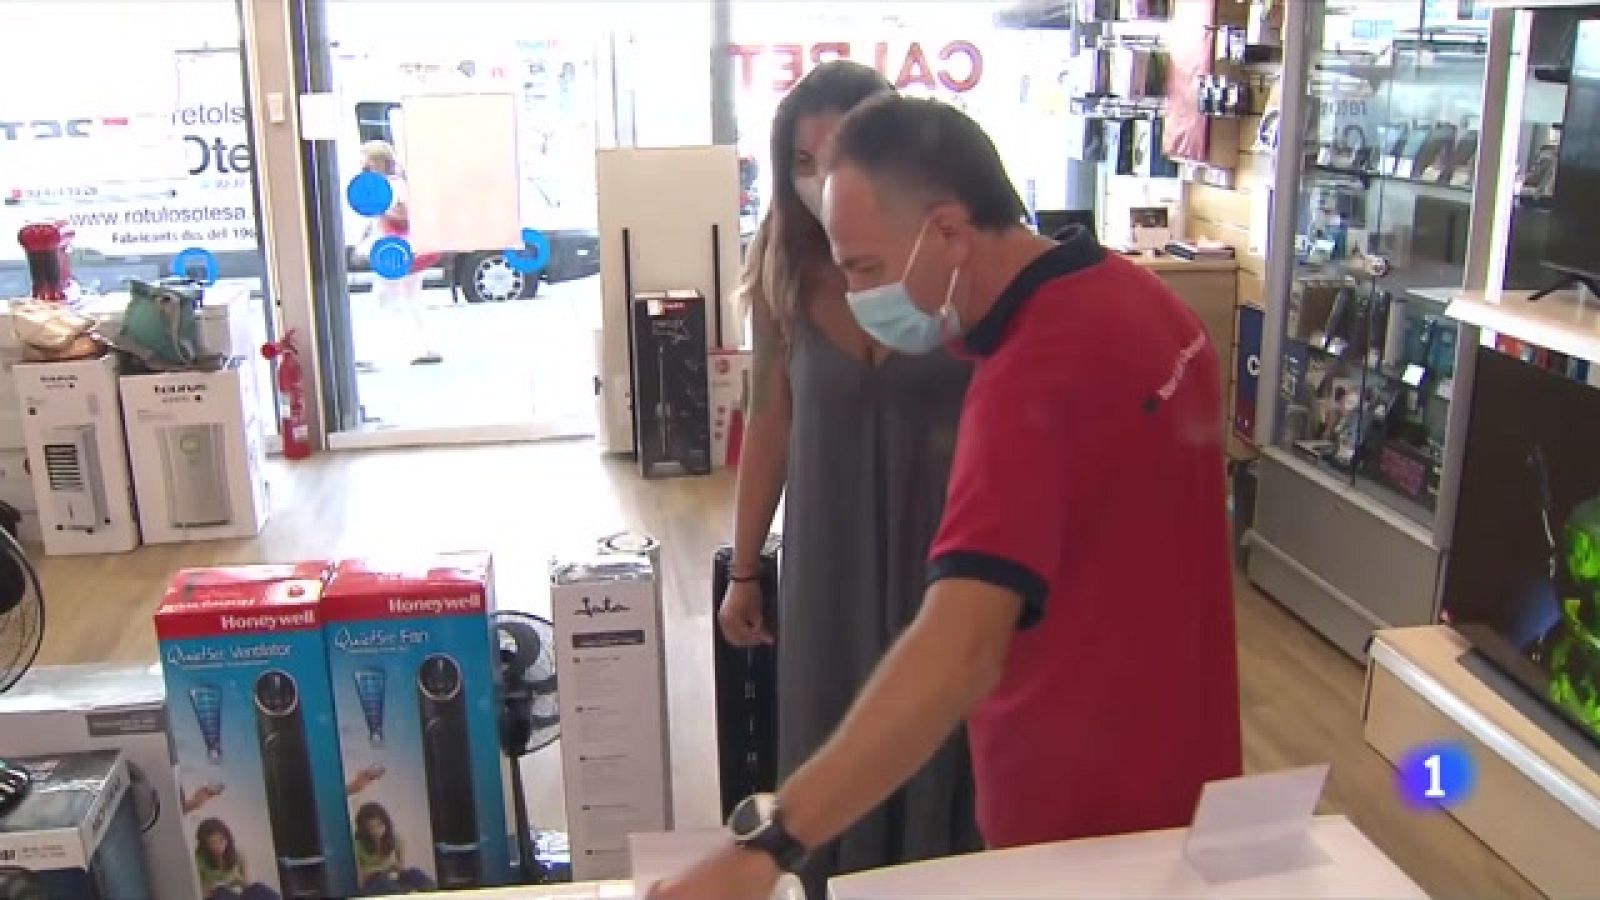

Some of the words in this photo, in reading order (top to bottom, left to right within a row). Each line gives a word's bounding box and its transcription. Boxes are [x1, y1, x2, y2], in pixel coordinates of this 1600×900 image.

[388, 592, 482, 613] Honeywell
[220, 609, 316, 630] Honeywell
[400, 629, 430, 644] Fan
